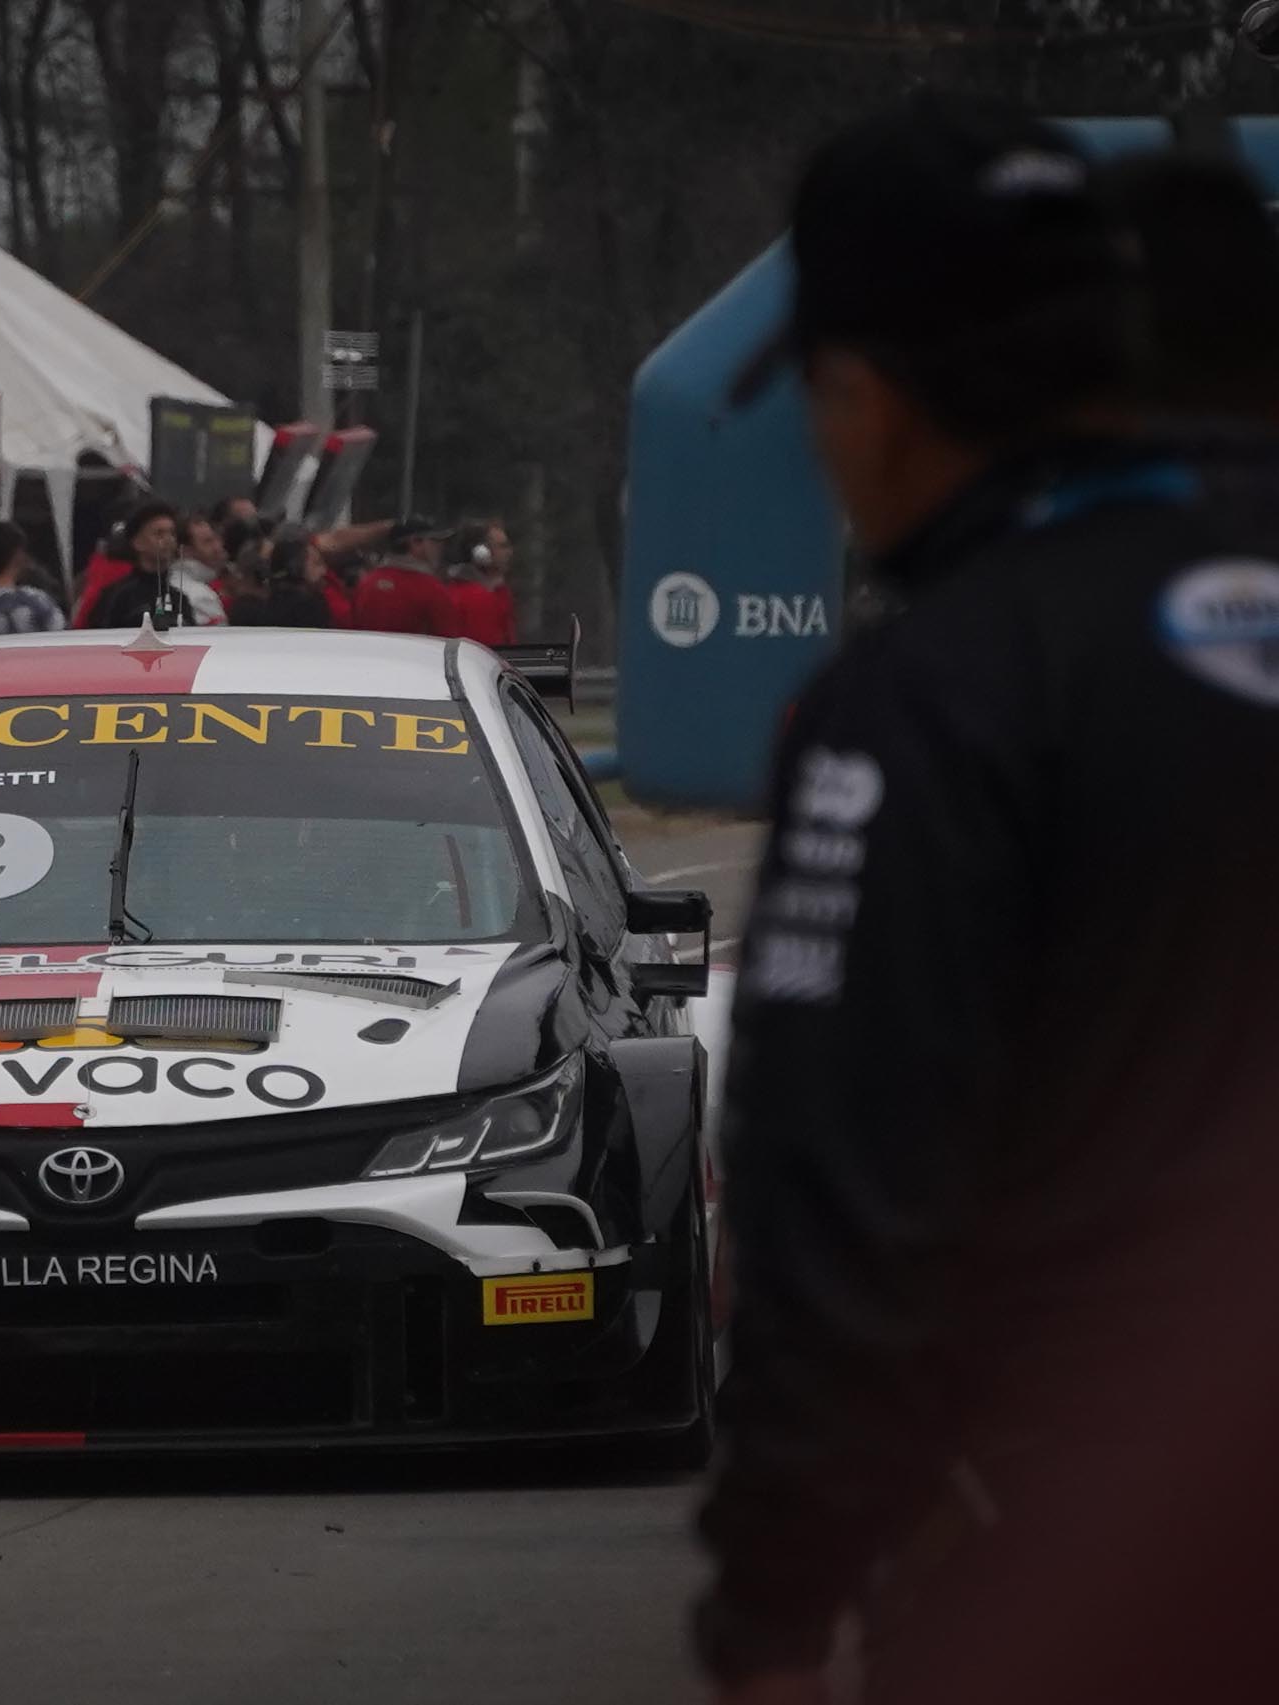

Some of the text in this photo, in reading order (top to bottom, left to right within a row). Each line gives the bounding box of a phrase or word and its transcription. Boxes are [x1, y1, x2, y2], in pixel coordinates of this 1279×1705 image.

[736, 593, 828, 637] BNA
[78, 1254, 218, 1285] REGINA
[495, 1282, 586, 1315] PIRELLI
